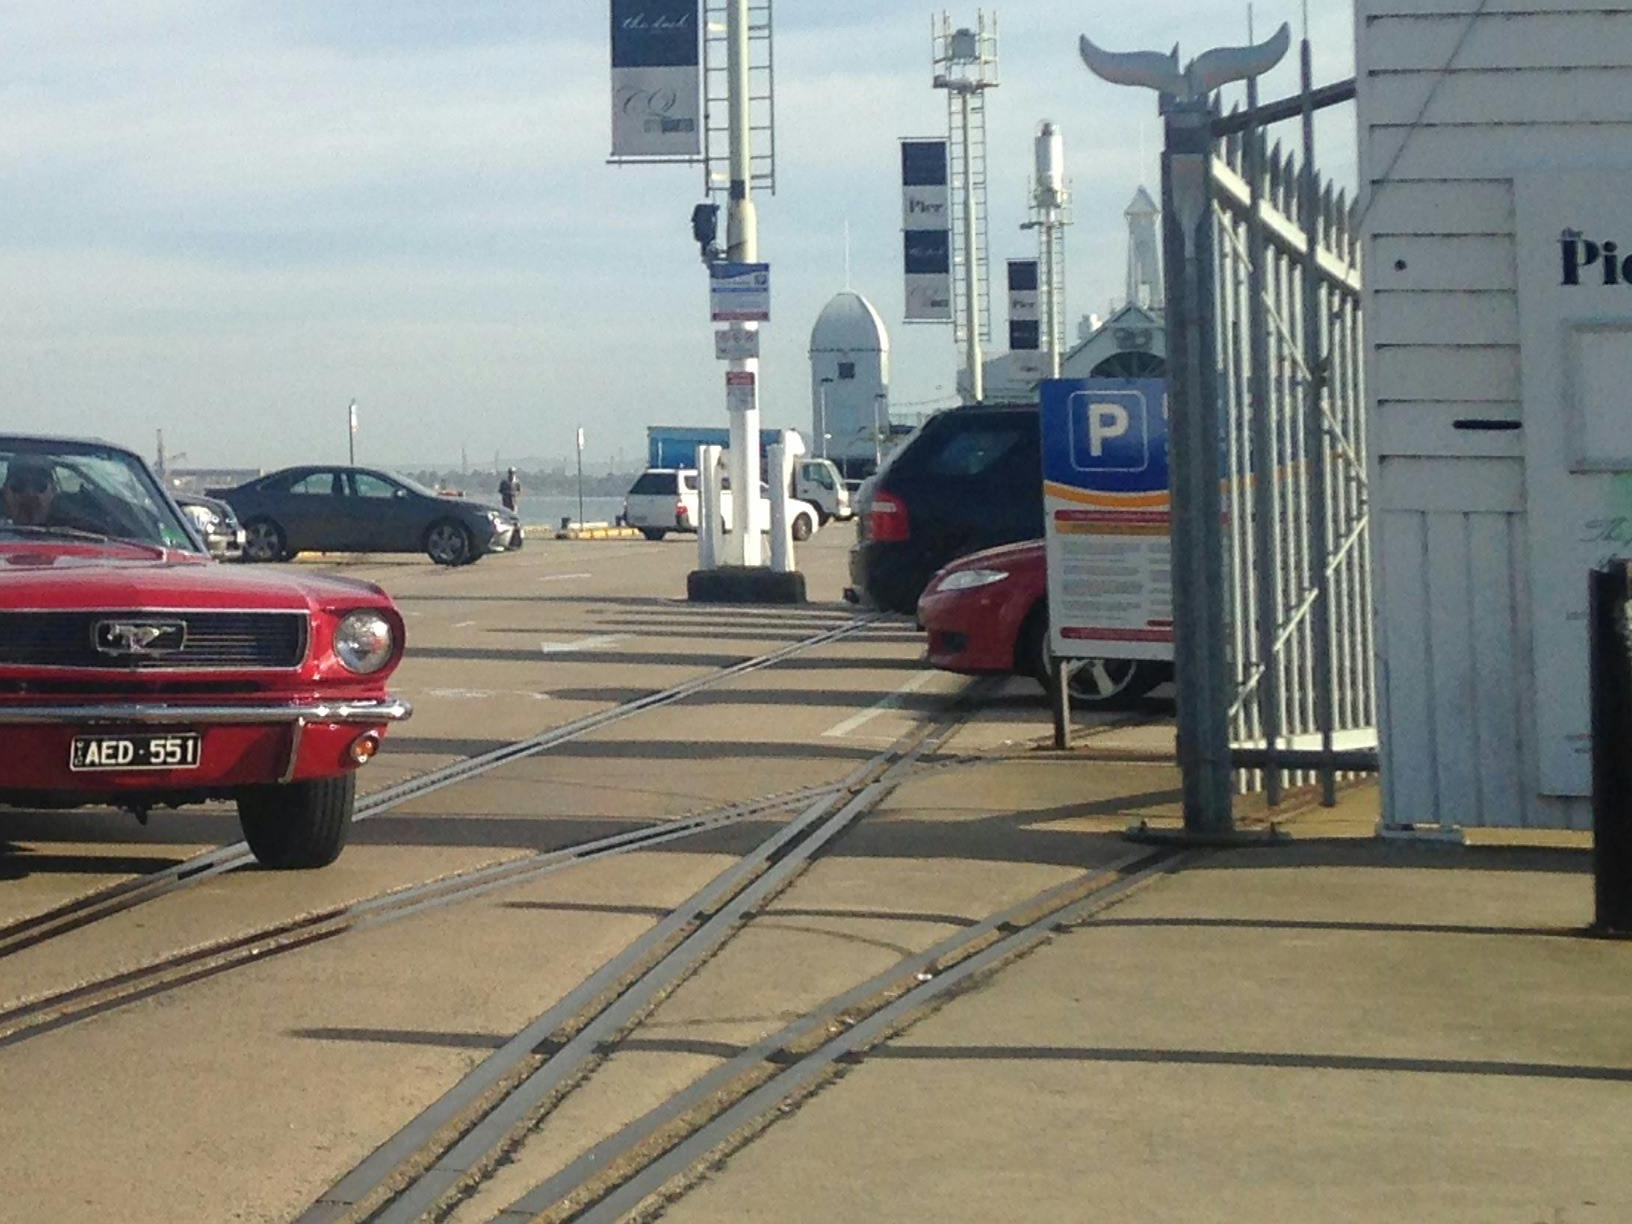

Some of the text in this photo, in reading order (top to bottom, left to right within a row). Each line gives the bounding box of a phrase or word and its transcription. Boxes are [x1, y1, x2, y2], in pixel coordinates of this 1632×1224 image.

[1088, 403, 1129, 457] P
[84, 739, 194, 765] AED 551
